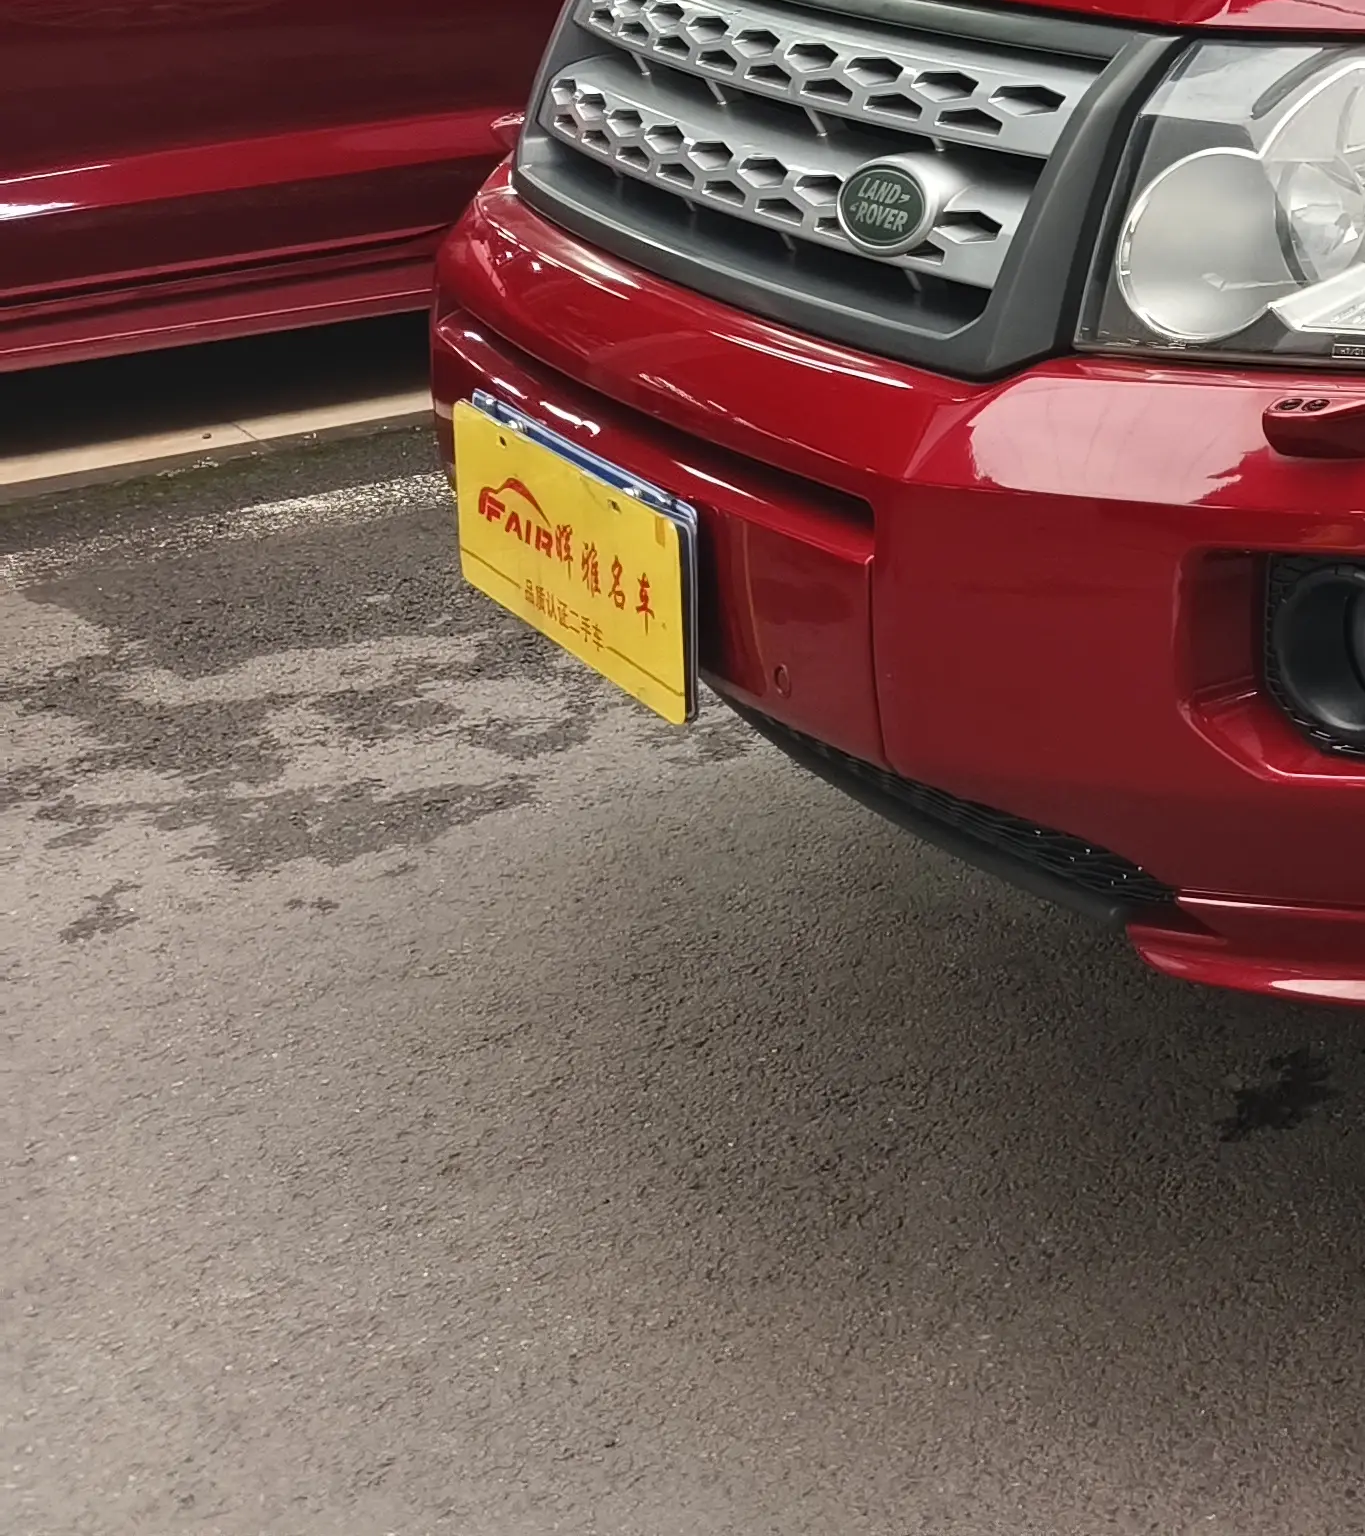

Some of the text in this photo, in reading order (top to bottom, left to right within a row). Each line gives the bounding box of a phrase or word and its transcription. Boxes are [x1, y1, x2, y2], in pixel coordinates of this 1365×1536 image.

[858, 177, 902, 204] LAND
[855, 201, 908, 232] ROVER
[479, 487, 553, 559] FAIR
[524, 578, 605, 652] 品质认证二手车
